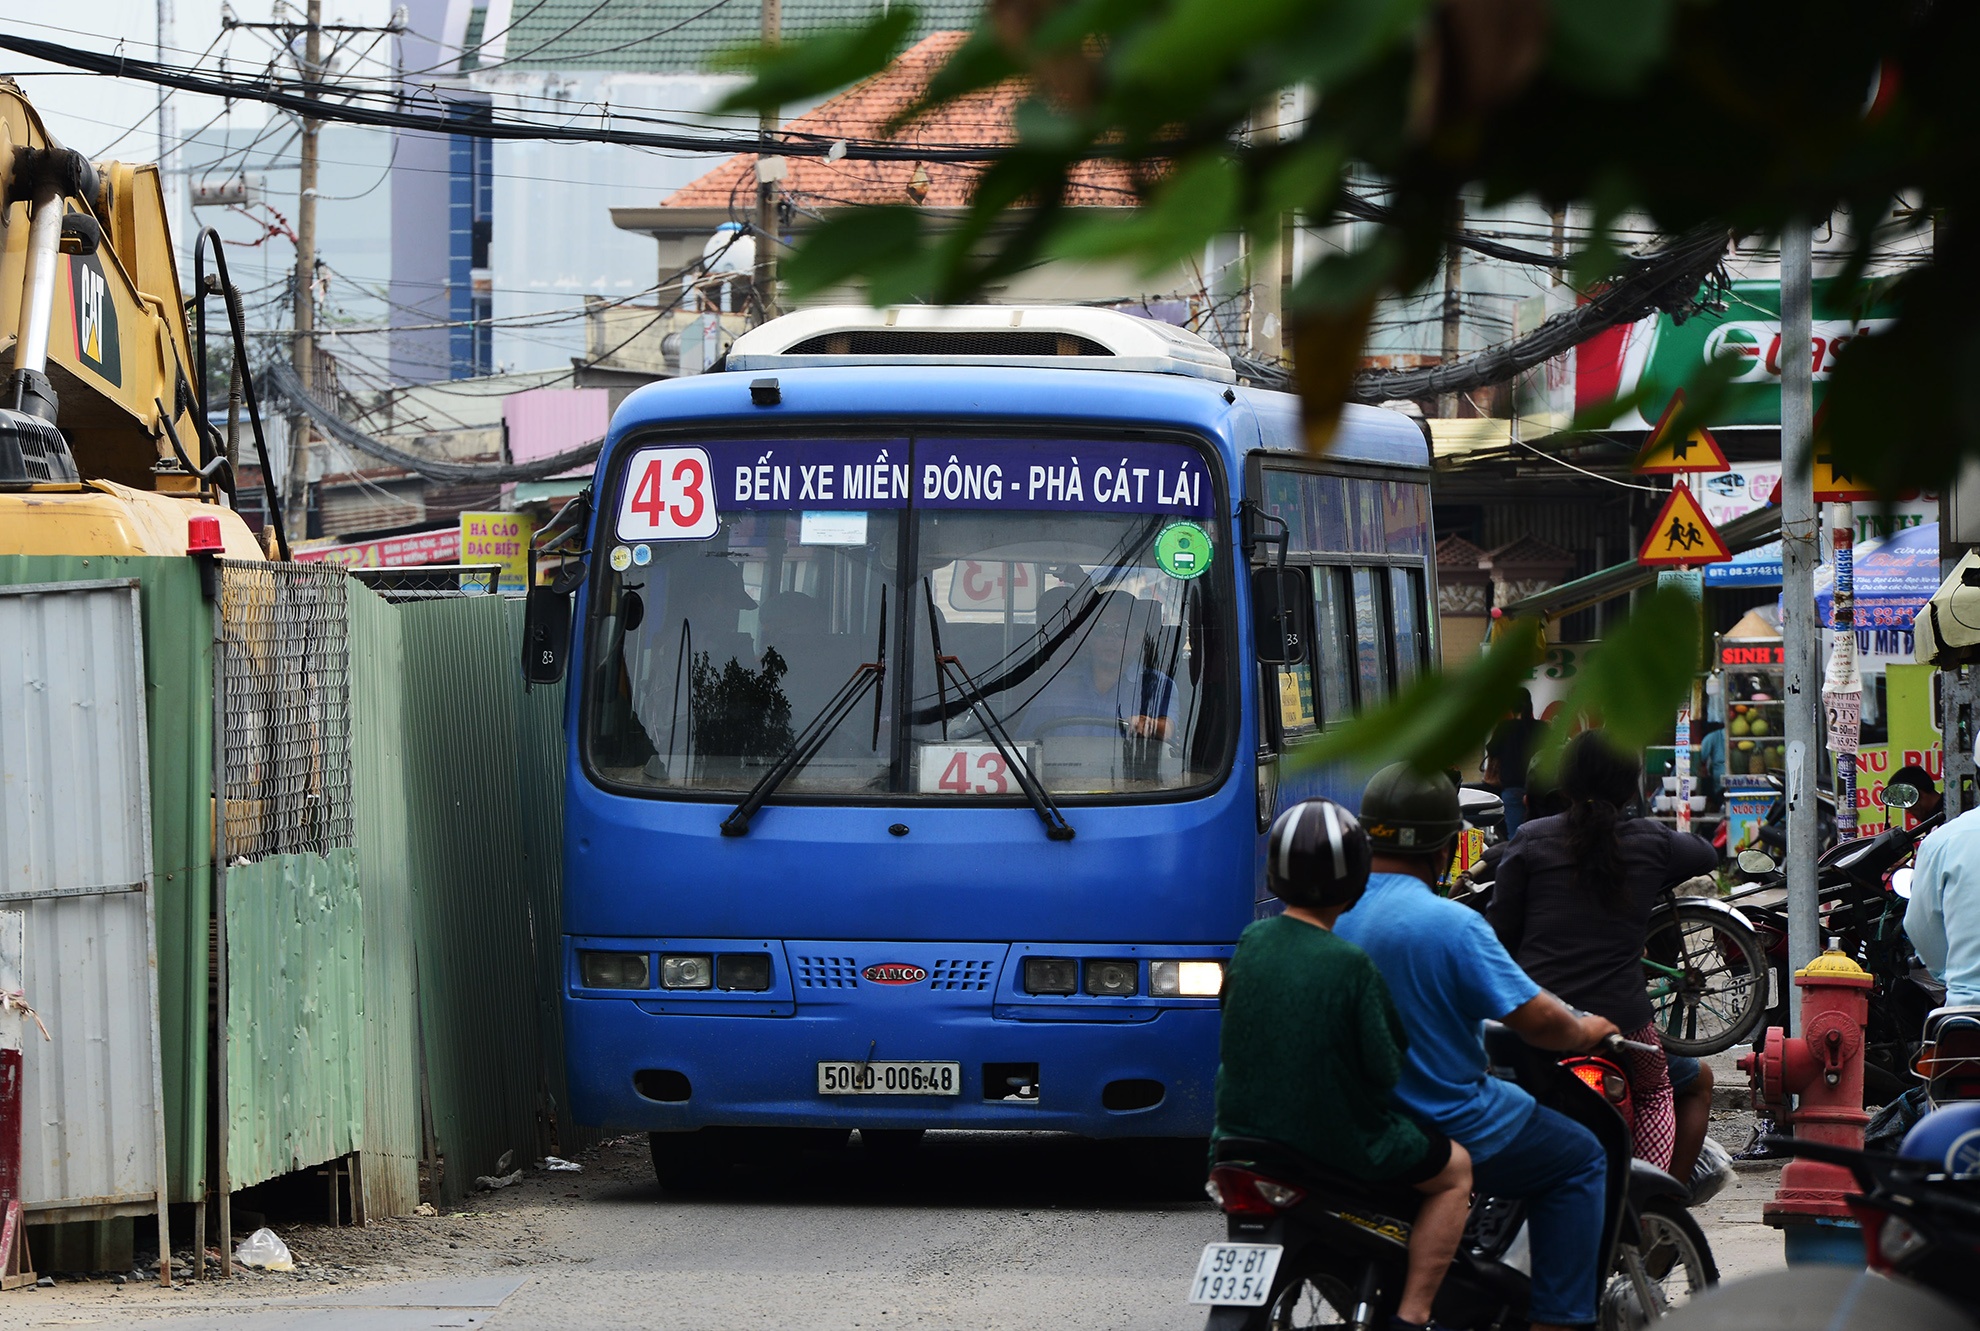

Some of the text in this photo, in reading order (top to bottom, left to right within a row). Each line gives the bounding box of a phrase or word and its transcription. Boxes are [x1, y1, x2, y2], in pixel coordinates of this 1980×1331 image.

[81, 263, 105, 365] CAT
[735, 450, 791, 501] BẾN
[799, 464, 835, 500] XE
[843, 448, 910, 500] MIỀN
[923, 454, 1003, 502] ĐÔNG
[1028, 456, 1084, 502] PHÀ
[1093, 457, 1150, 503] CÁT
[1157, 461, 1200, 507] LÁI
[631, 458, 705, 527] 43
[495, 539, 521, 559] BIỆT
[542, 650, 554, 665] 83
[1721, 648, 1770, 664] SINH
[938, 751, 1008, 794] 43
[866, 968, 926, 980] SAMCO
[1212, 1249, 1266, 1274] 59-B1
[1198, 1276, 1264, 1301] 193.54
